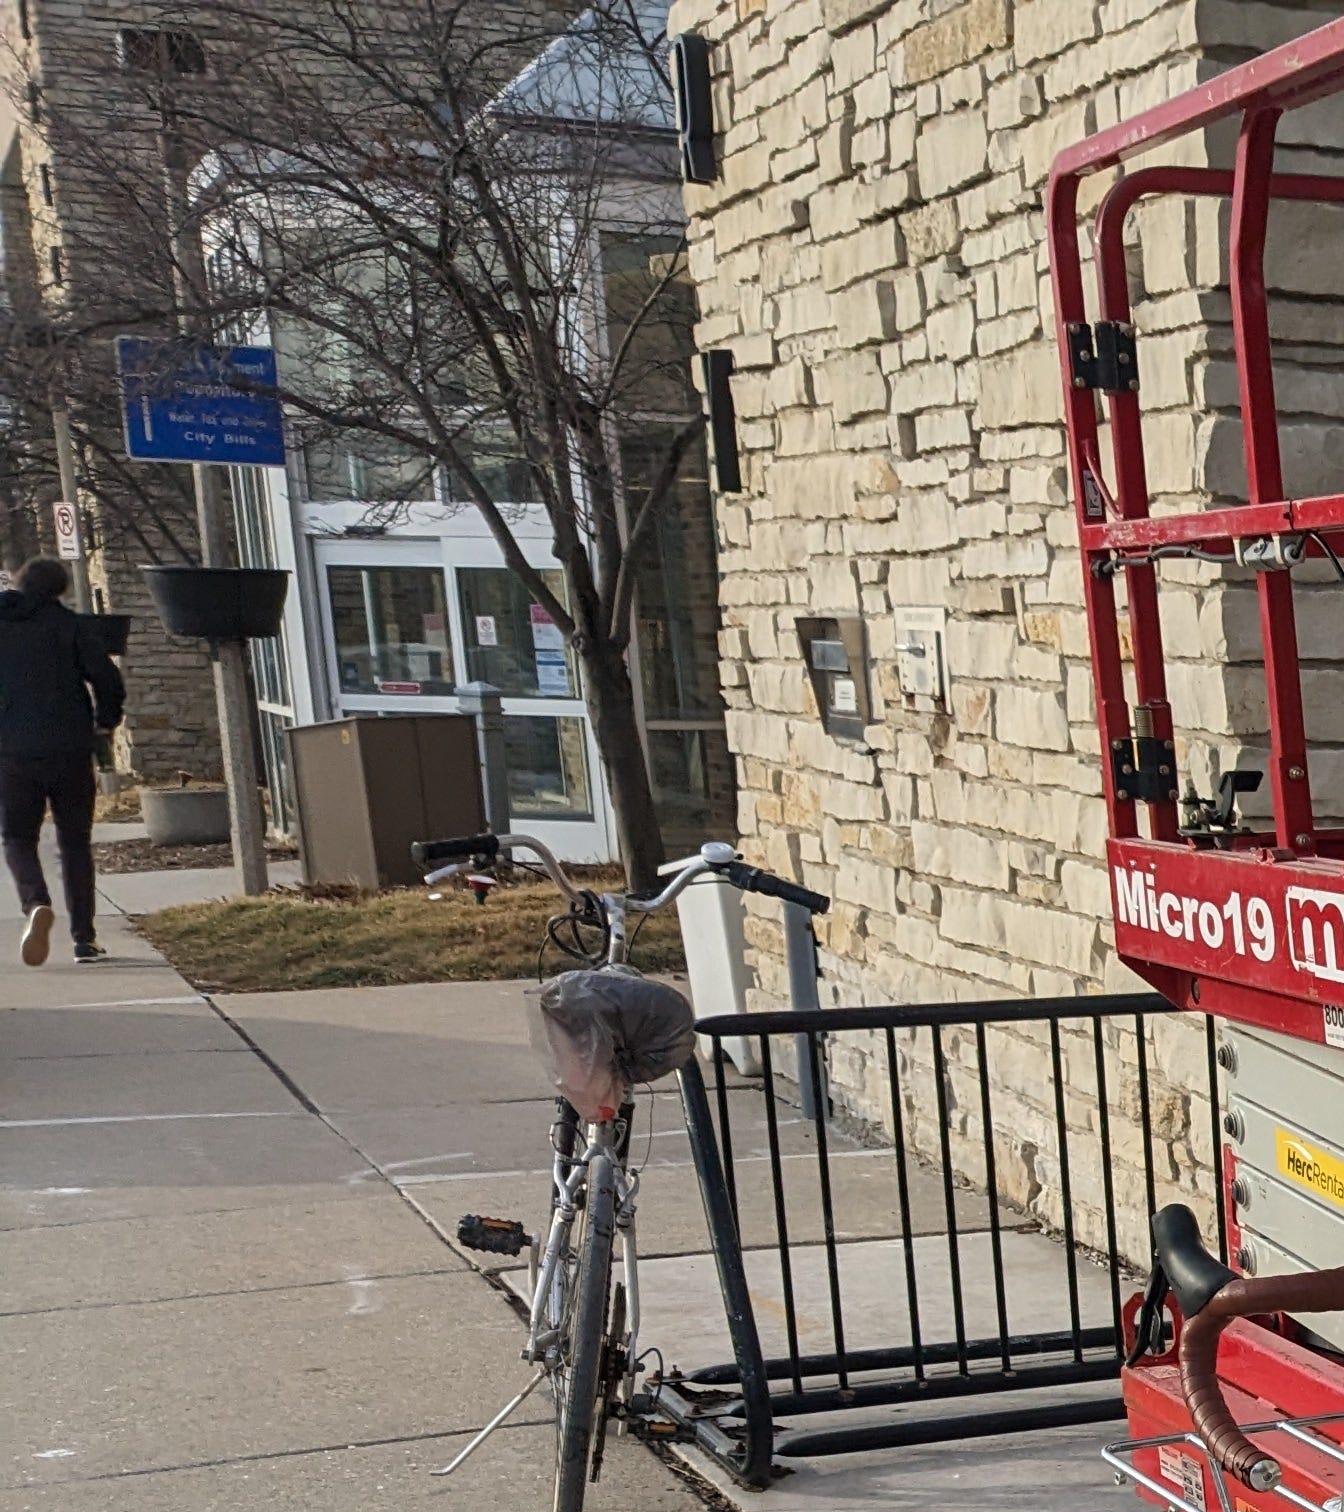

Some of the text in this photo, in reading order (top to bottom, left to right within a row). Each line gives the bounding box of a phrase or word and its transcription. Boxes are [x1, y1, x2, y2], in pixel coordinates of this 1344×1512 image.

[184, 431, 257, 445] City Bills
[1114, 864, 1275, 962] Micro19
